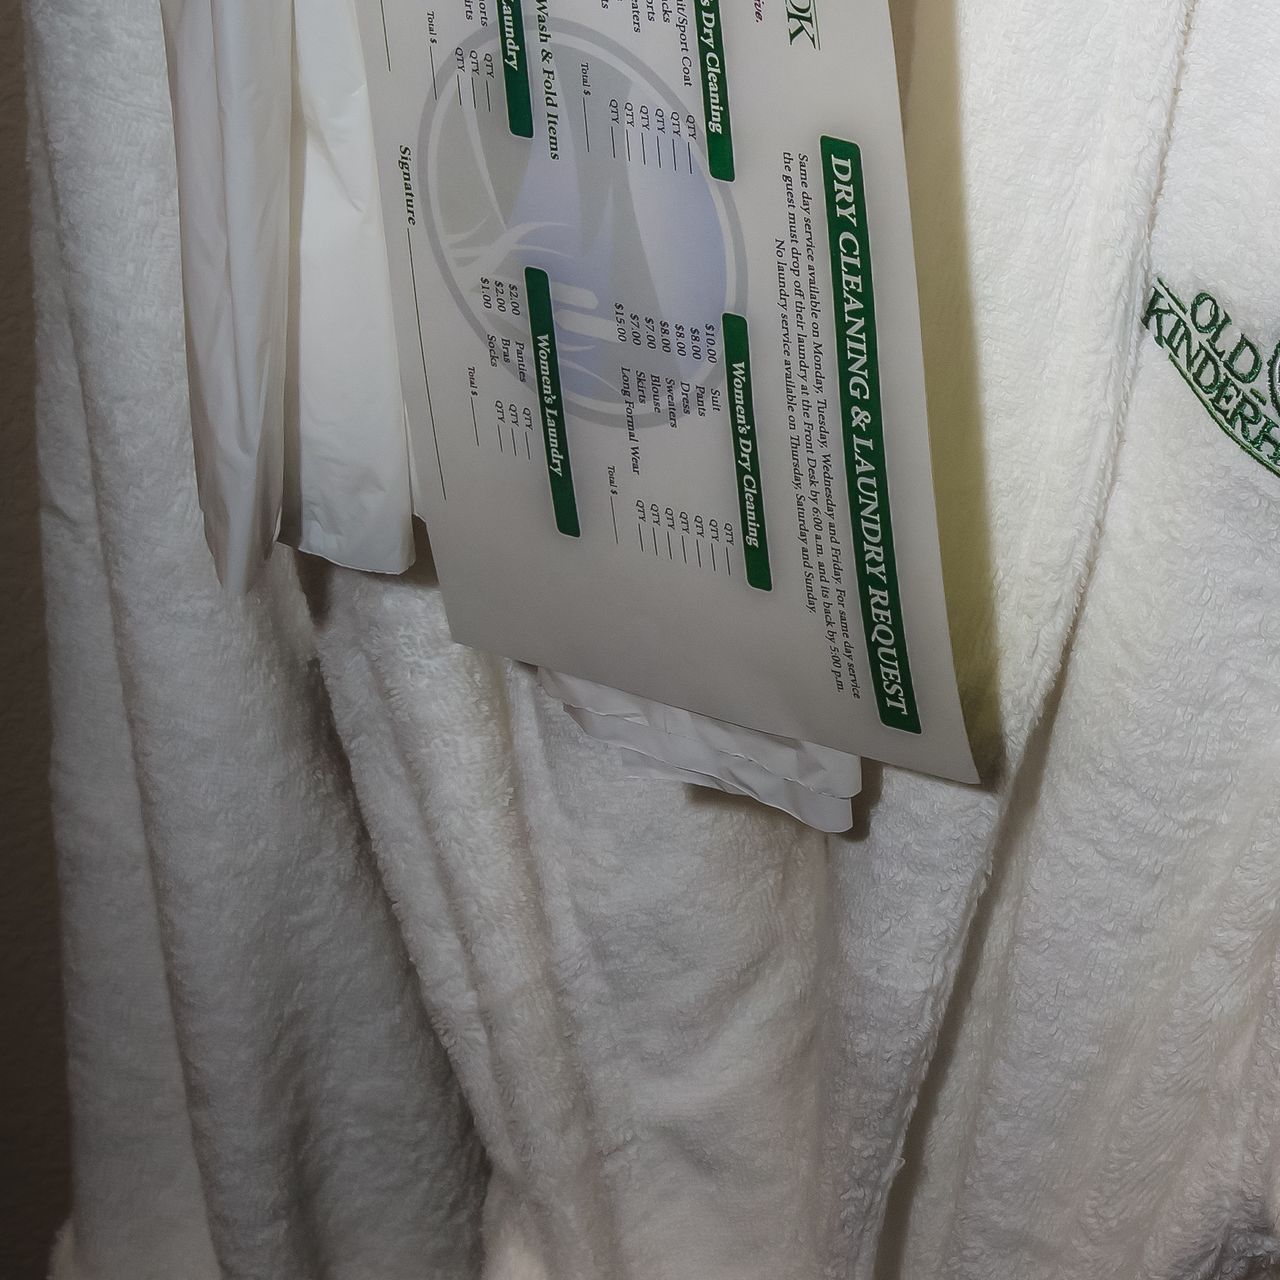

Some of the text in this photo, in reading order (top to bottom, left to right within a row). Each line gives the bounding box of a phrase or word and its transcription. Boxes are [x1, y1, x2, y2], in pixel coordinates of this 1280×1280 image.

[425, 10, 436, 36] Total
[453, 46, 465, 73] QTY
[468, 49, 480, 76] QTY
[540, 48, 553, 64] &
[697, 9, 717, 49] Dry
[482, 52, 494, 79] QTY
[541, 68, 558, 108] Fold
[579, 61, 590, 87] Total
[680, 55, 693, 87] Coat
[701, 50, 725, 135] Cleaning
[545, 111, 563, 161] Items
[607, 98, 619, 124] QTY
[622, 101, 635, 127] QTY
[637, 104, 650, 130] QTY
[653, 107, 665, 134] QTY
[668, 110, 681, 137] QTY
[684, 113, 696, 140] QTY
[396, 143, 418, 226] Signature
[467, 365, 477, 389] Total
[478, 276, 505, 424] $1.00 Socks QTY
[493, 279, 519, 427] $2.00 Bras QTY
[507, 283, 533, 430] $2.00 Panties QTY
[1190, 292, 1262, 384] OLD
[535, 331, 563, 477] Women's Laundry
[612, 301, 646, 523] $15.00 Long Formal Wear QTY
[628, 312, 661, 527] $7.00 Skirts QTY
[643, 316, 675, 530] $7.00 Blouse QTY
[658, 319, 690, 534] $8.00 Sweaters QTY
[673, 323, 705, 538] $8.00 Dress QTY
[688, 326, 719, 542] $8.00 Pants QTY
[702, 322, 734, 545] $10.00 Suit QTY
[772, 238, 819, 615] No laundry service available on Thursday, Saturday and Sunday.
[780, 150, 844, 694] the guest must drop off their laundry at the Front Desk by 6:00 a.m. and its back by 5:00 p.m.
[796, 152, 864, 700] Same day service available on Monday, Tuesday, Wednesday and Friday. For same day service
[830, 154, 907, 715] DRY CLEANING & LAUNDRY REQUEST
[606, 464, 618, 495] Total $
[730, 359, 761, 548] Women's Dry Cleaning
